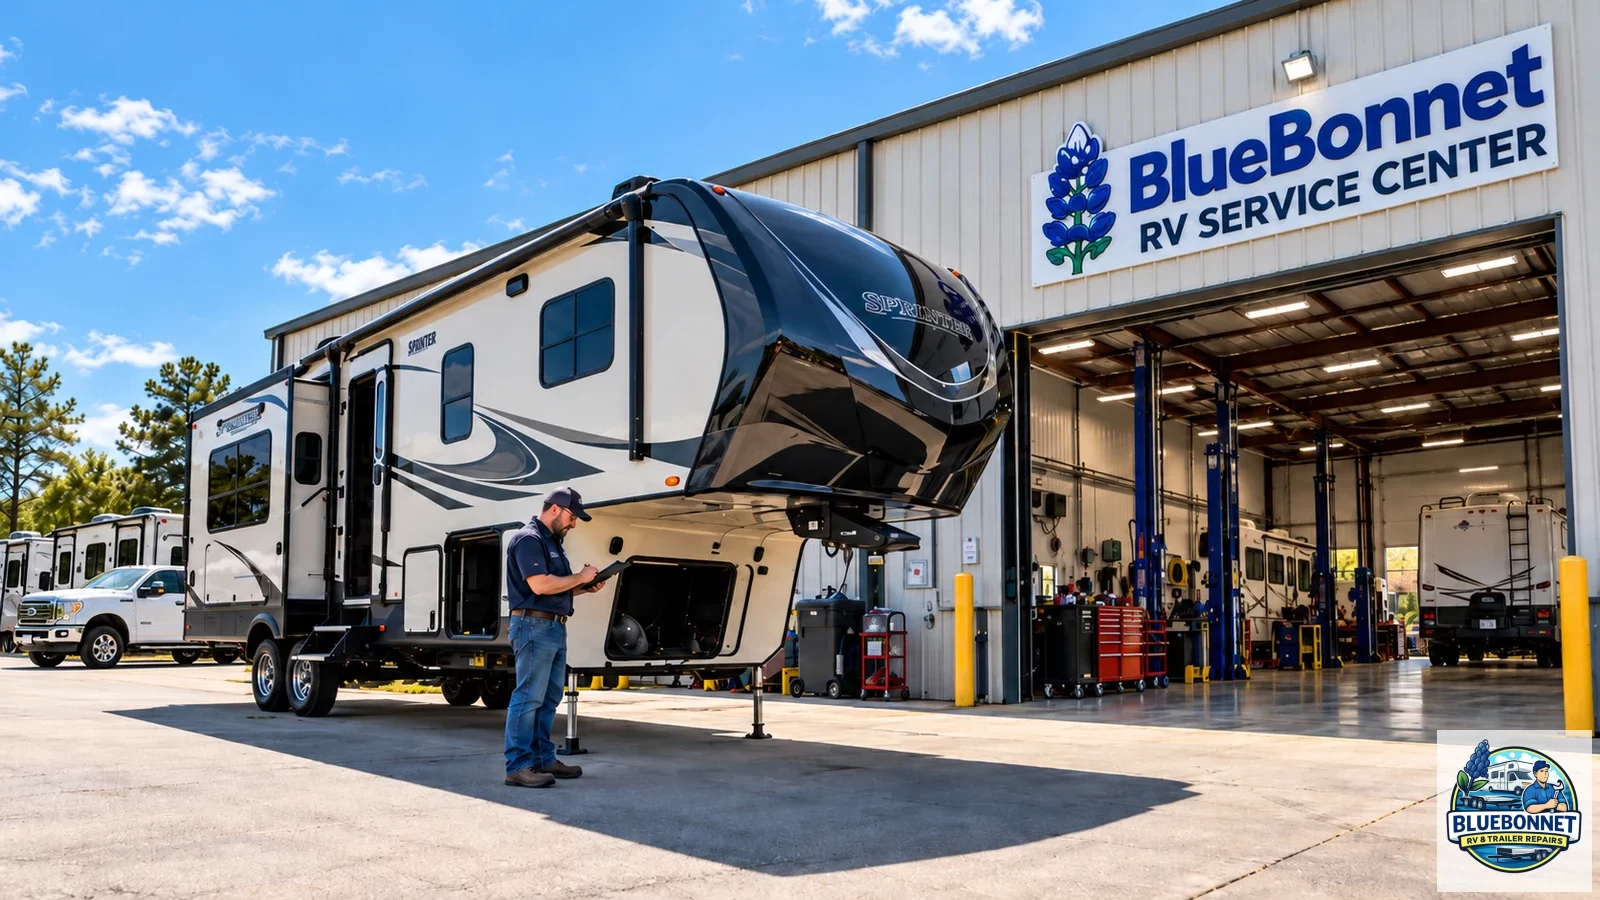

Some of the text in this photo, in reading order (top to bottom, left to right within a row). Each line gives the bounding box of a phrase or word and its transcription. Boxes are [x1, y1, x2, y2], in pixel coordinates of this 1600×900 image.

[1129, 43, 1545, 214] BlueBonnet
[1140, 122, 1548, 254] RV SERVICE CENTER
[862, 291, 974, 341] SPRINTER
